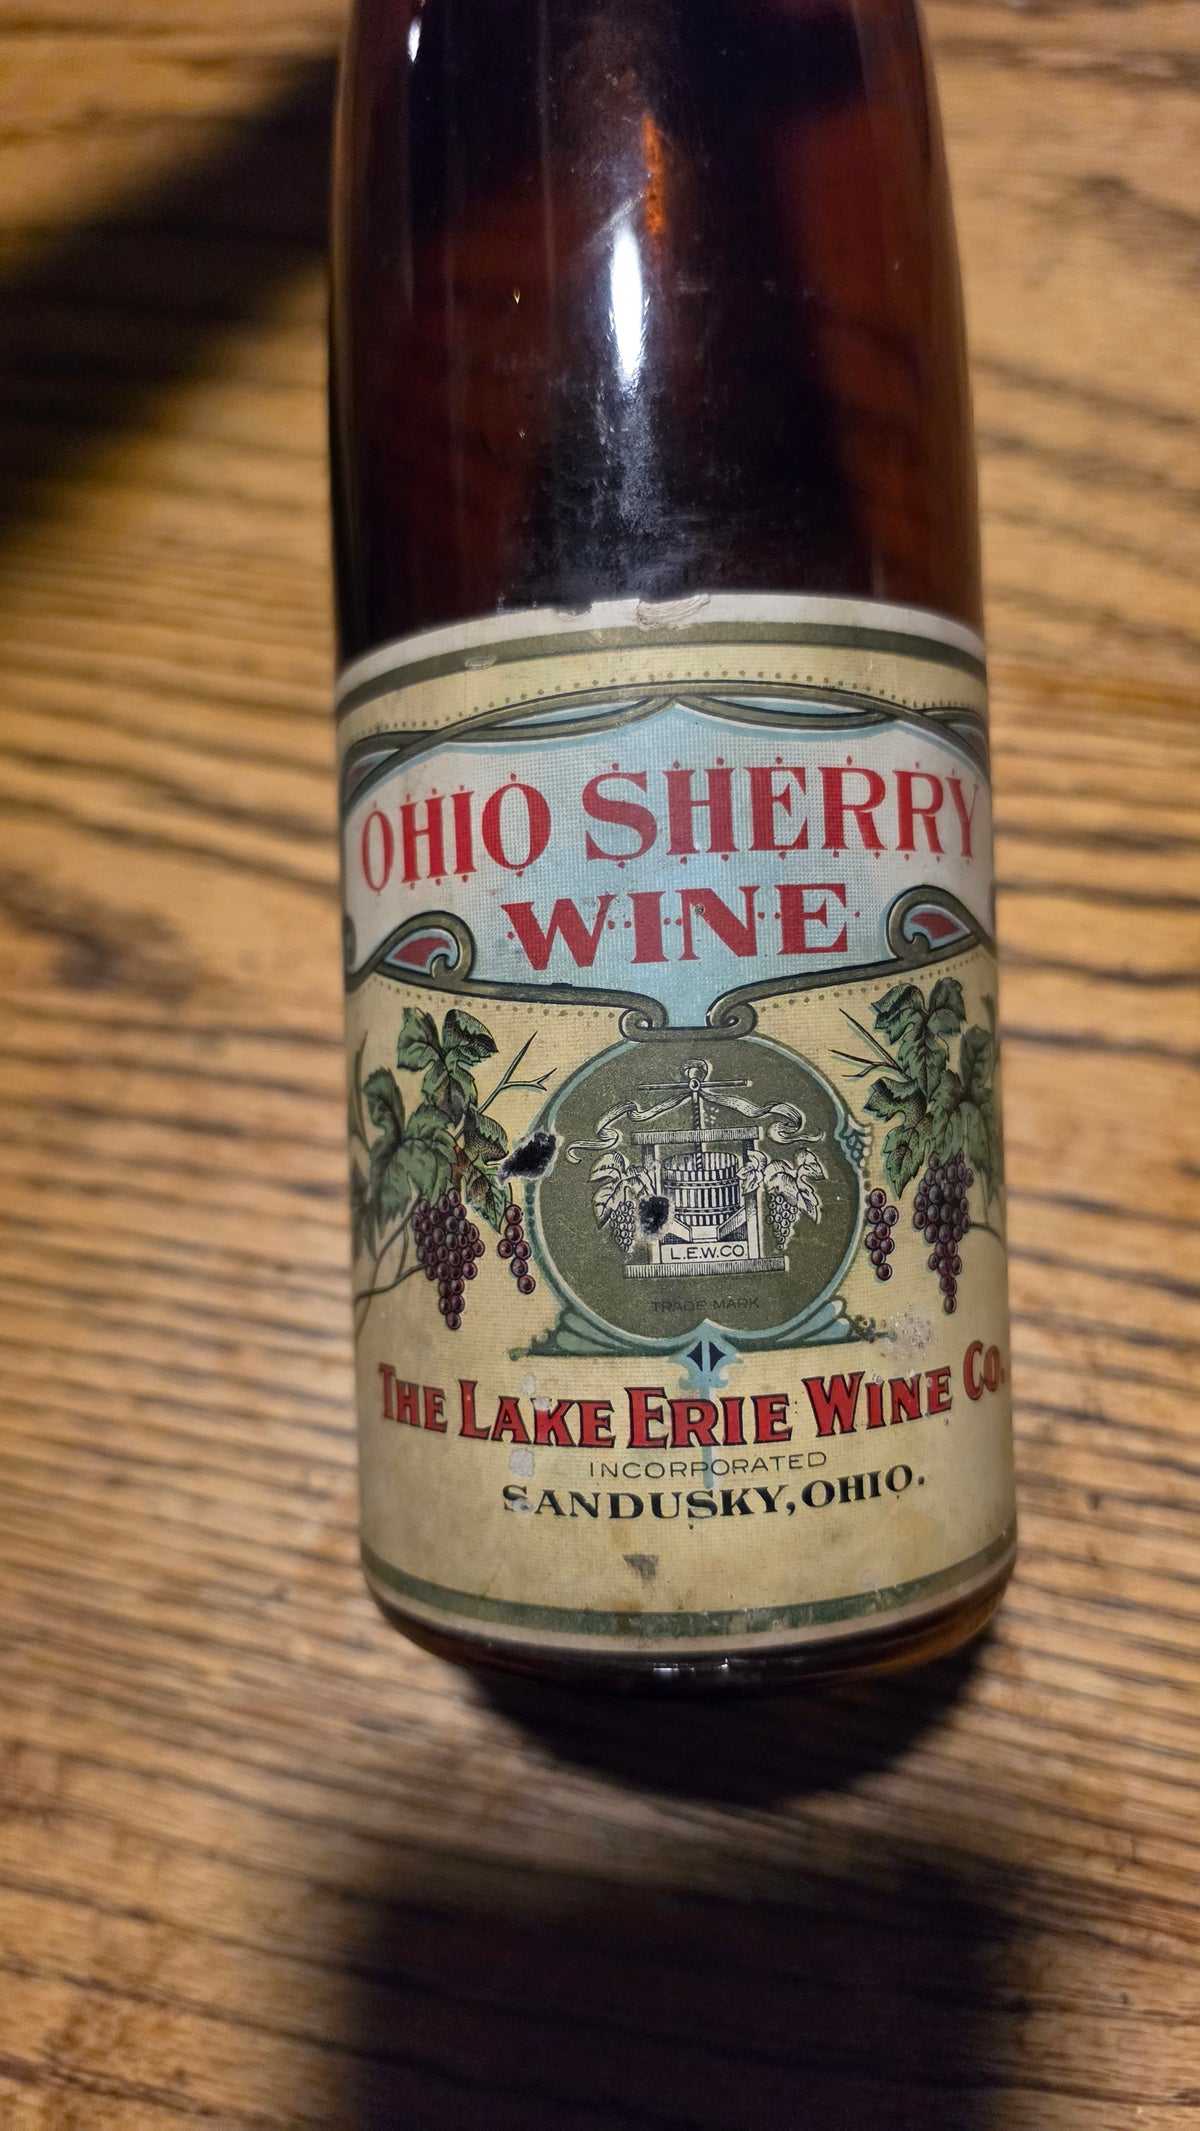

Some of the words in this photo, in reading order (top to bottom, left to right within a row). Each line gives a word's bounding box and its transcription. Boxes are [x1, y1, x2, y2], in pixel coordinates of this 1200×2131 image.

[361, 780, 552, 893] OHIO
[581, 762, 979, 864] SHERRY
[499, 882, 850, 972] WINE
[652, 1300, 707, 1313] TRADE
[713, 1298, 760, 1310] MARK
[458, 1379, 616, 1449] LAKE
[624, 1386, 795, 1449] ERIE
[589, 1451, 828, 1479] INCORPORATED
